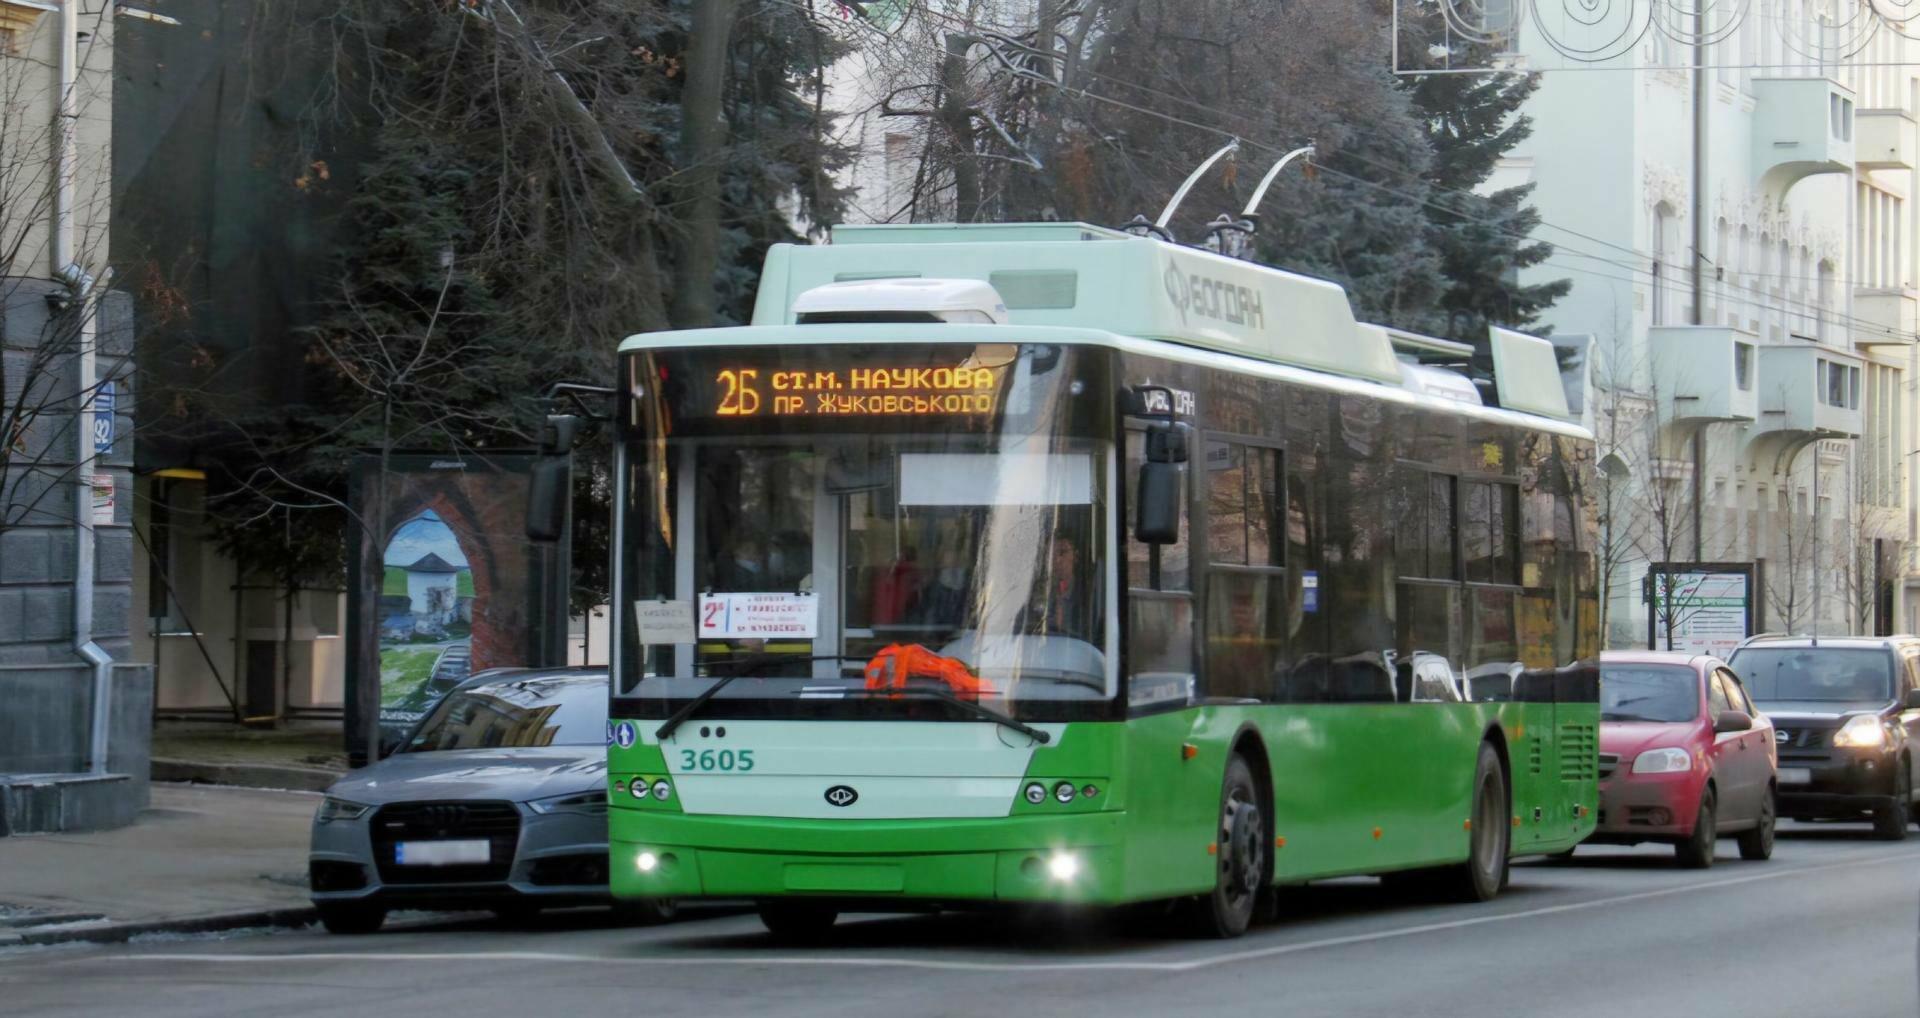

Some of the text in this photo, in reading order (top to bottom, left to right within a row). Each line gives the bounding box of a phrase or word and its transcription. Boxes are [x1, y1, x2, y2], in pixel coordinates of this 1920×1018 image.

[850, 367, 994, 390] НАУКОВА
[715, 369, 760, 415] 2Б
[774, 392, 991, 414] ПР. ЖУКОВСЬКОГО
[680, 749, 755, 771] 3605
